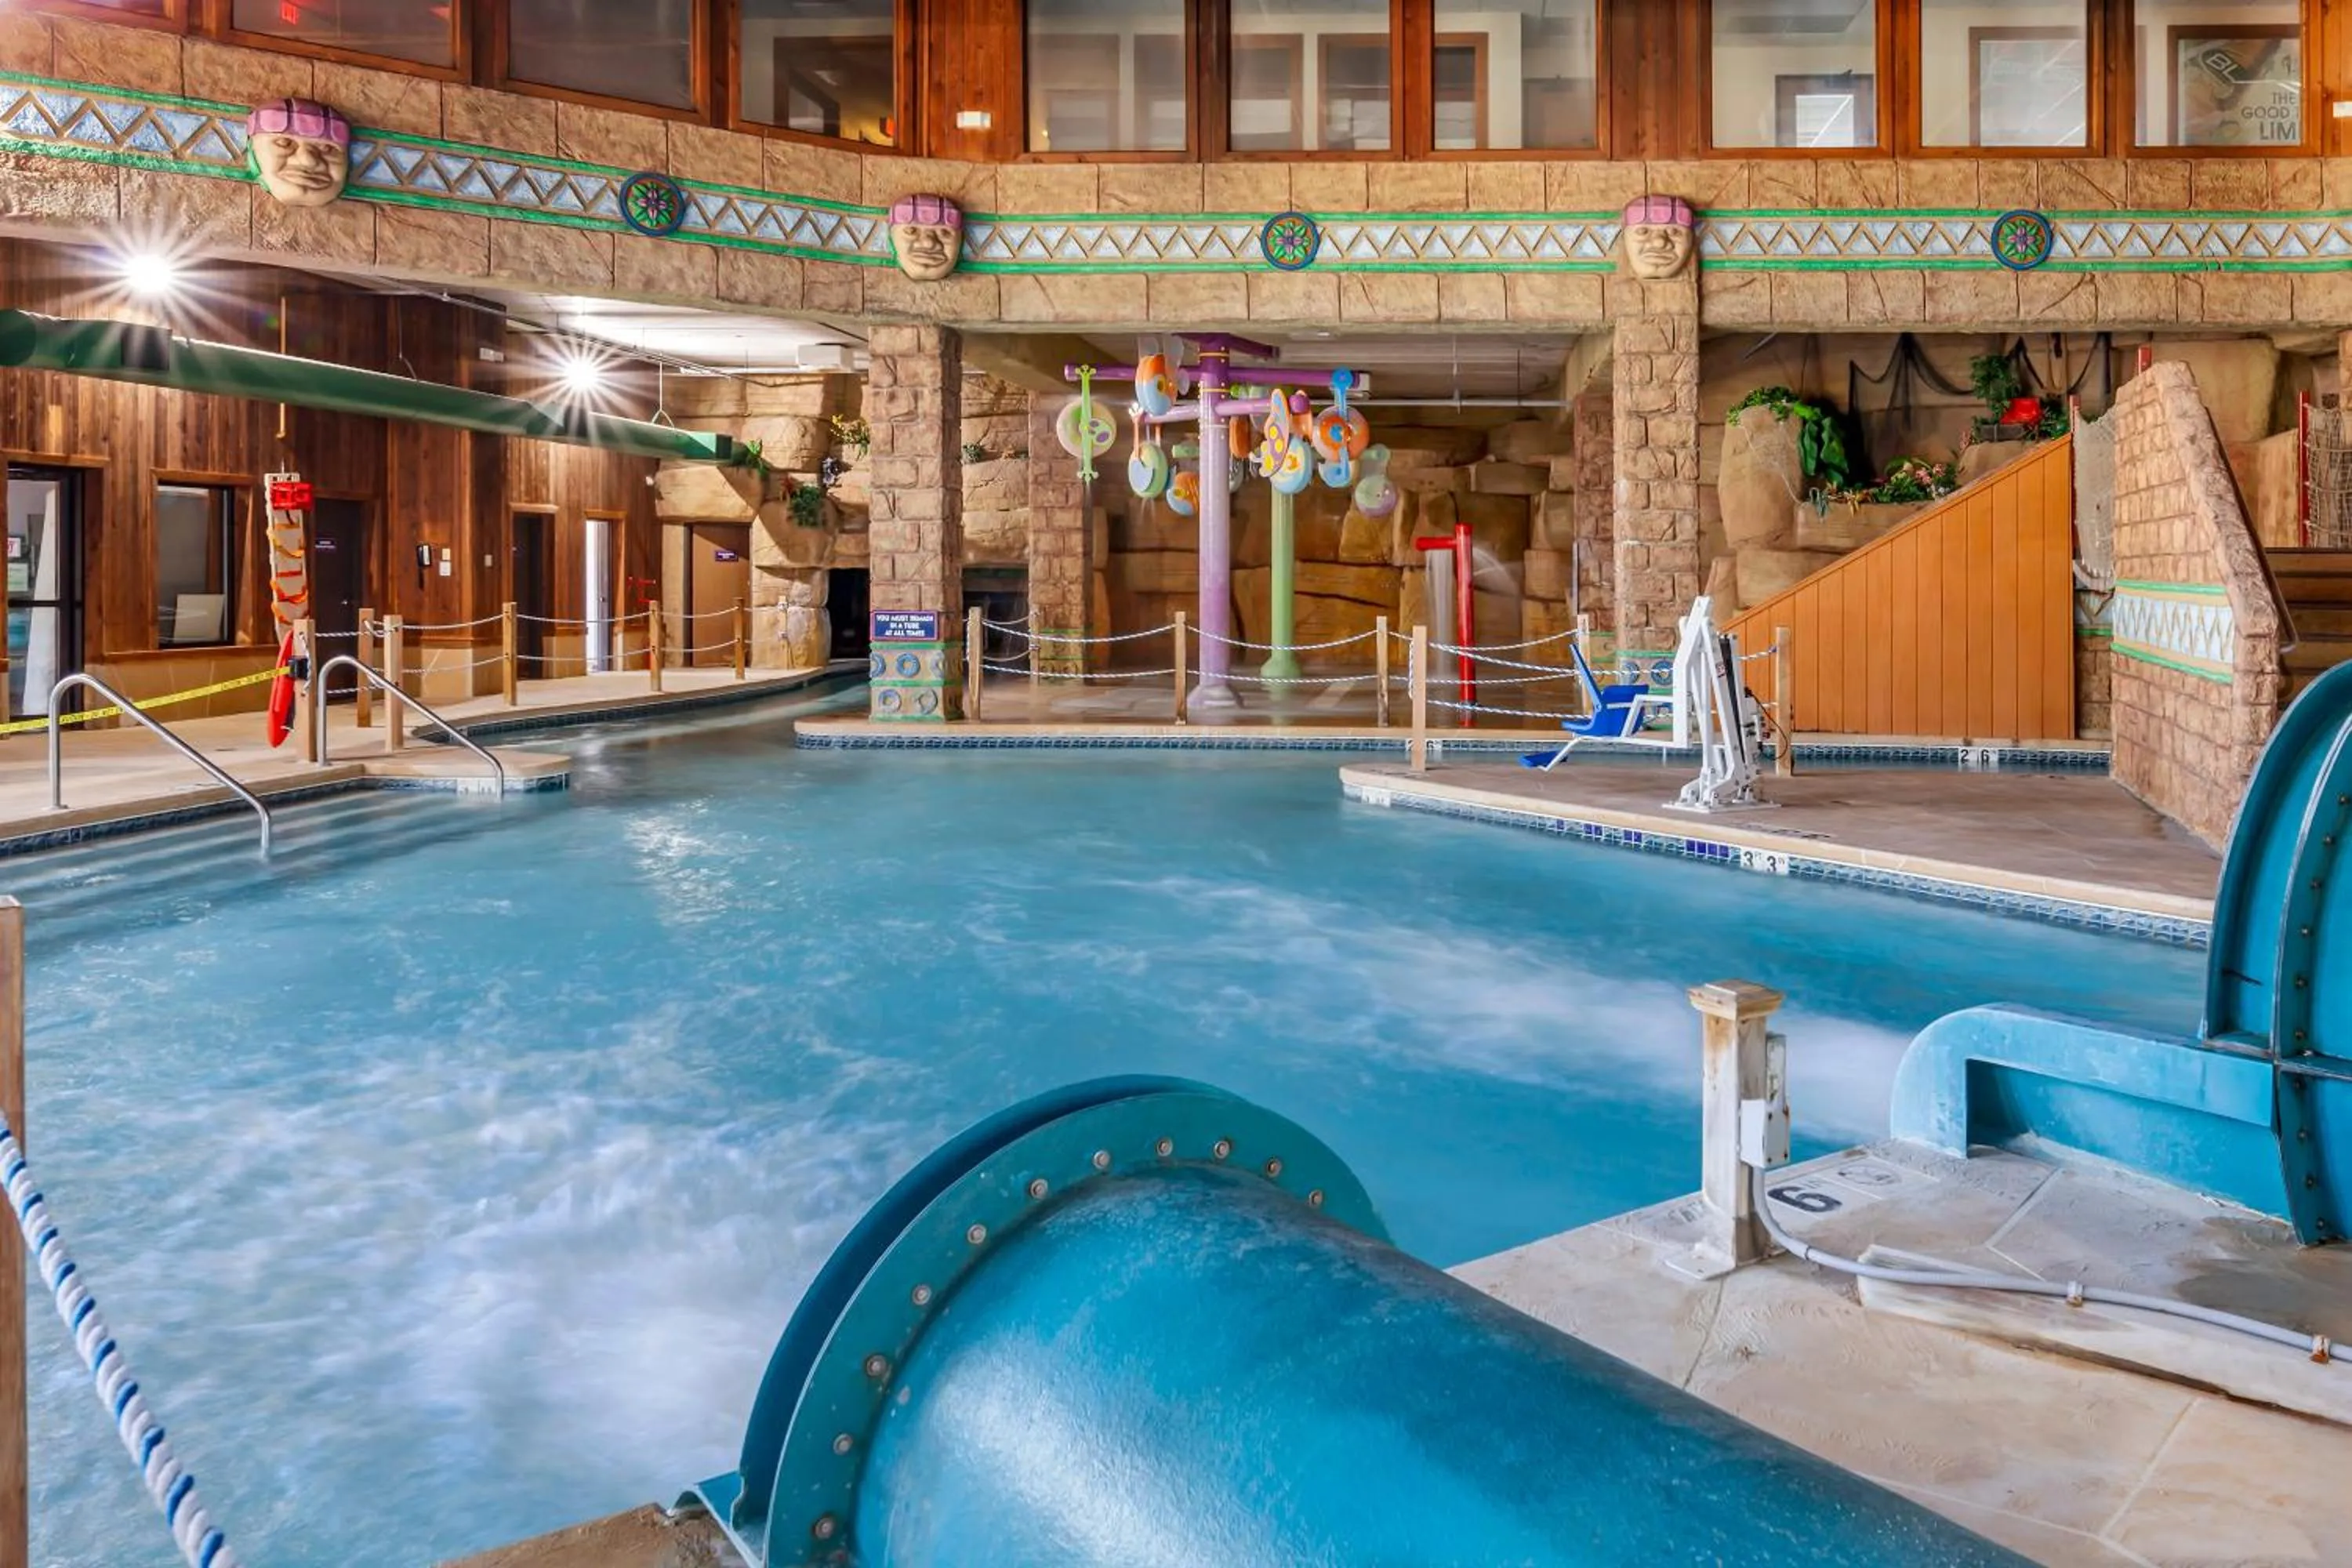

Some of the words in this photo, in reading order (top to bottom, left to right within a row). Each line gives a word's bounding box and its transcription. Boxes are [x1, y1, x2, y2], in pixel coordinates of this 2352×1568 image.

[2272, 92, 2296, 104] THE
[2241, 106, 2290, 119] GOOD
[2259, 122, 2296, 140] LIM
[1961, 749, 1969, 763] 2
[1981, 749, 1990, 764] 6
[1744, 851, 1754, 866] 3
[1767, 855, 1777, 872] 3
